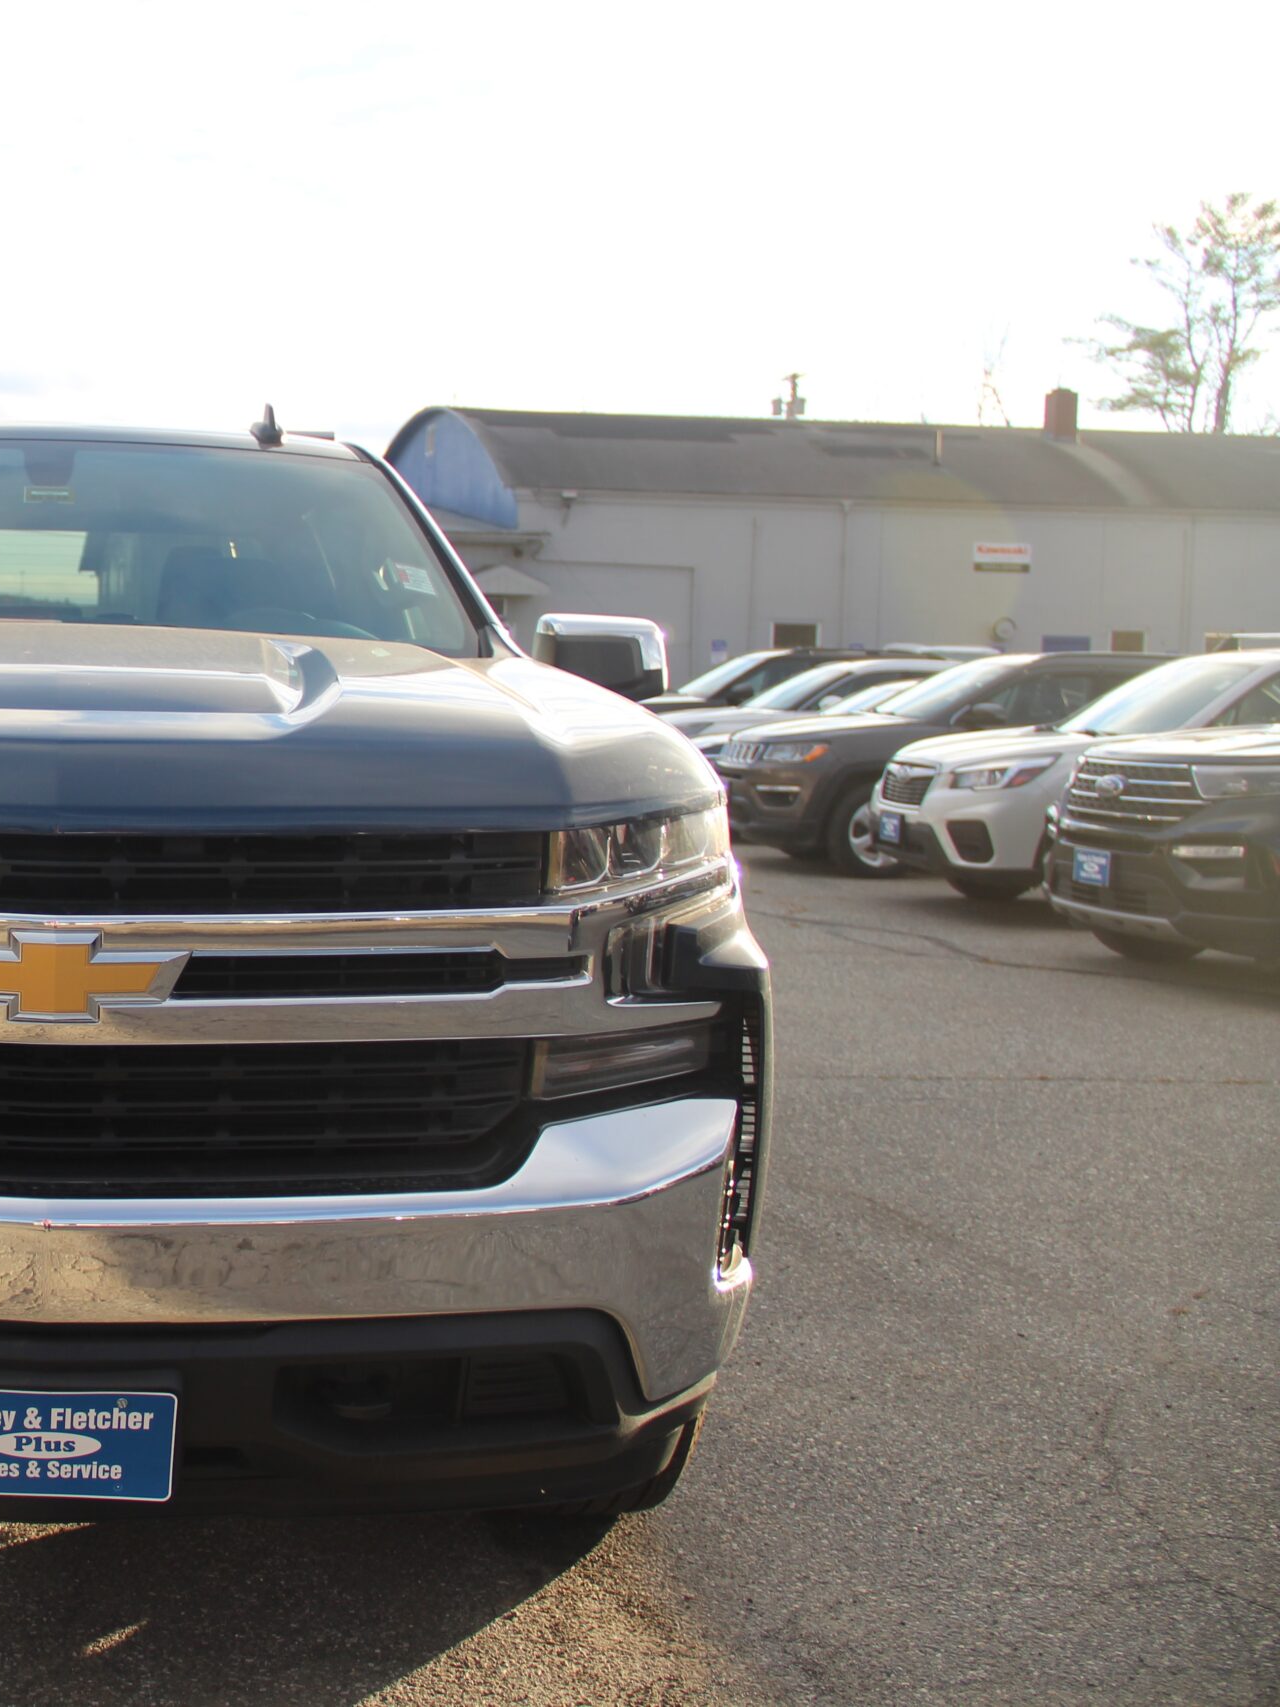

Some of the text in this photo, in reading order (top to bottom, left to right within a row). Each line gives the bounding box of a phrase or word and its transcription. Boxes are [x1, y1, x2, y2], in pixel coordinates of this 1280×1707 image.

[23, 1407, 42, 1429] &
[50, 1407, 154, 1430] Fletcher
[14, 1435, 76, 1452] Plus
[26, 1460, 41, 1478] &
[46, 1461, 122, 1479] Service
